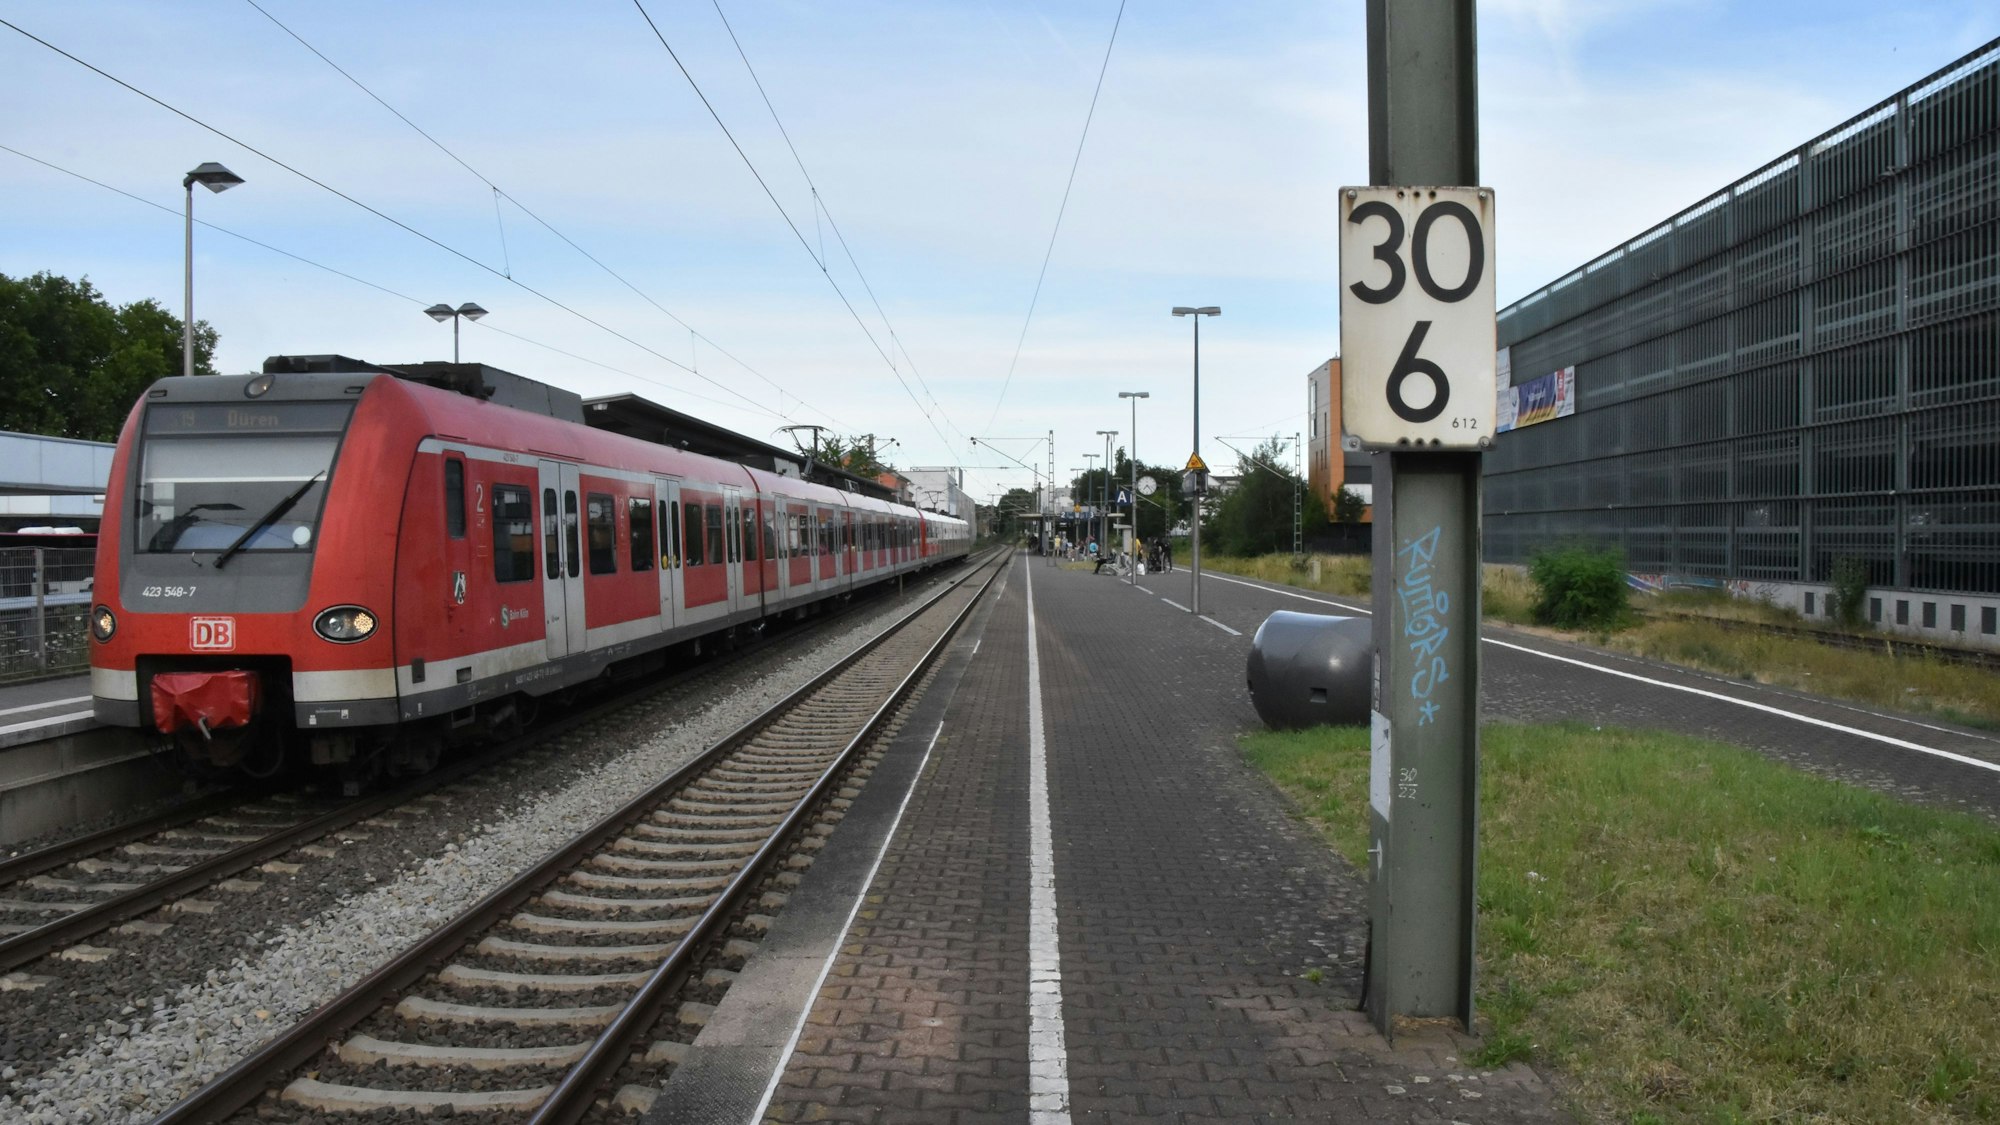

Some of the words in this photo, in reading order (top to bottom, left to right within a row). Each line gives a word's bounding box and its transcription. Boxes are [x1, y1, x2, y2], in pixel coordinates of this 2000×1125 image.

[1347, 200, 1485, 305] 30
[1385, 320, 1450, 424] 6
[227, 409, 279, 427] Düren
[1452, 417, 1478, 430] 612
[475, 483, 484, 513] 2
[1117, 490, 1127, 503] A
[142, 586, 162, 597] 423
[164, 586, 197, 597] 548-7
[196, 623, 230, 646] DB
[1398, 787, 1417, 800] 22
